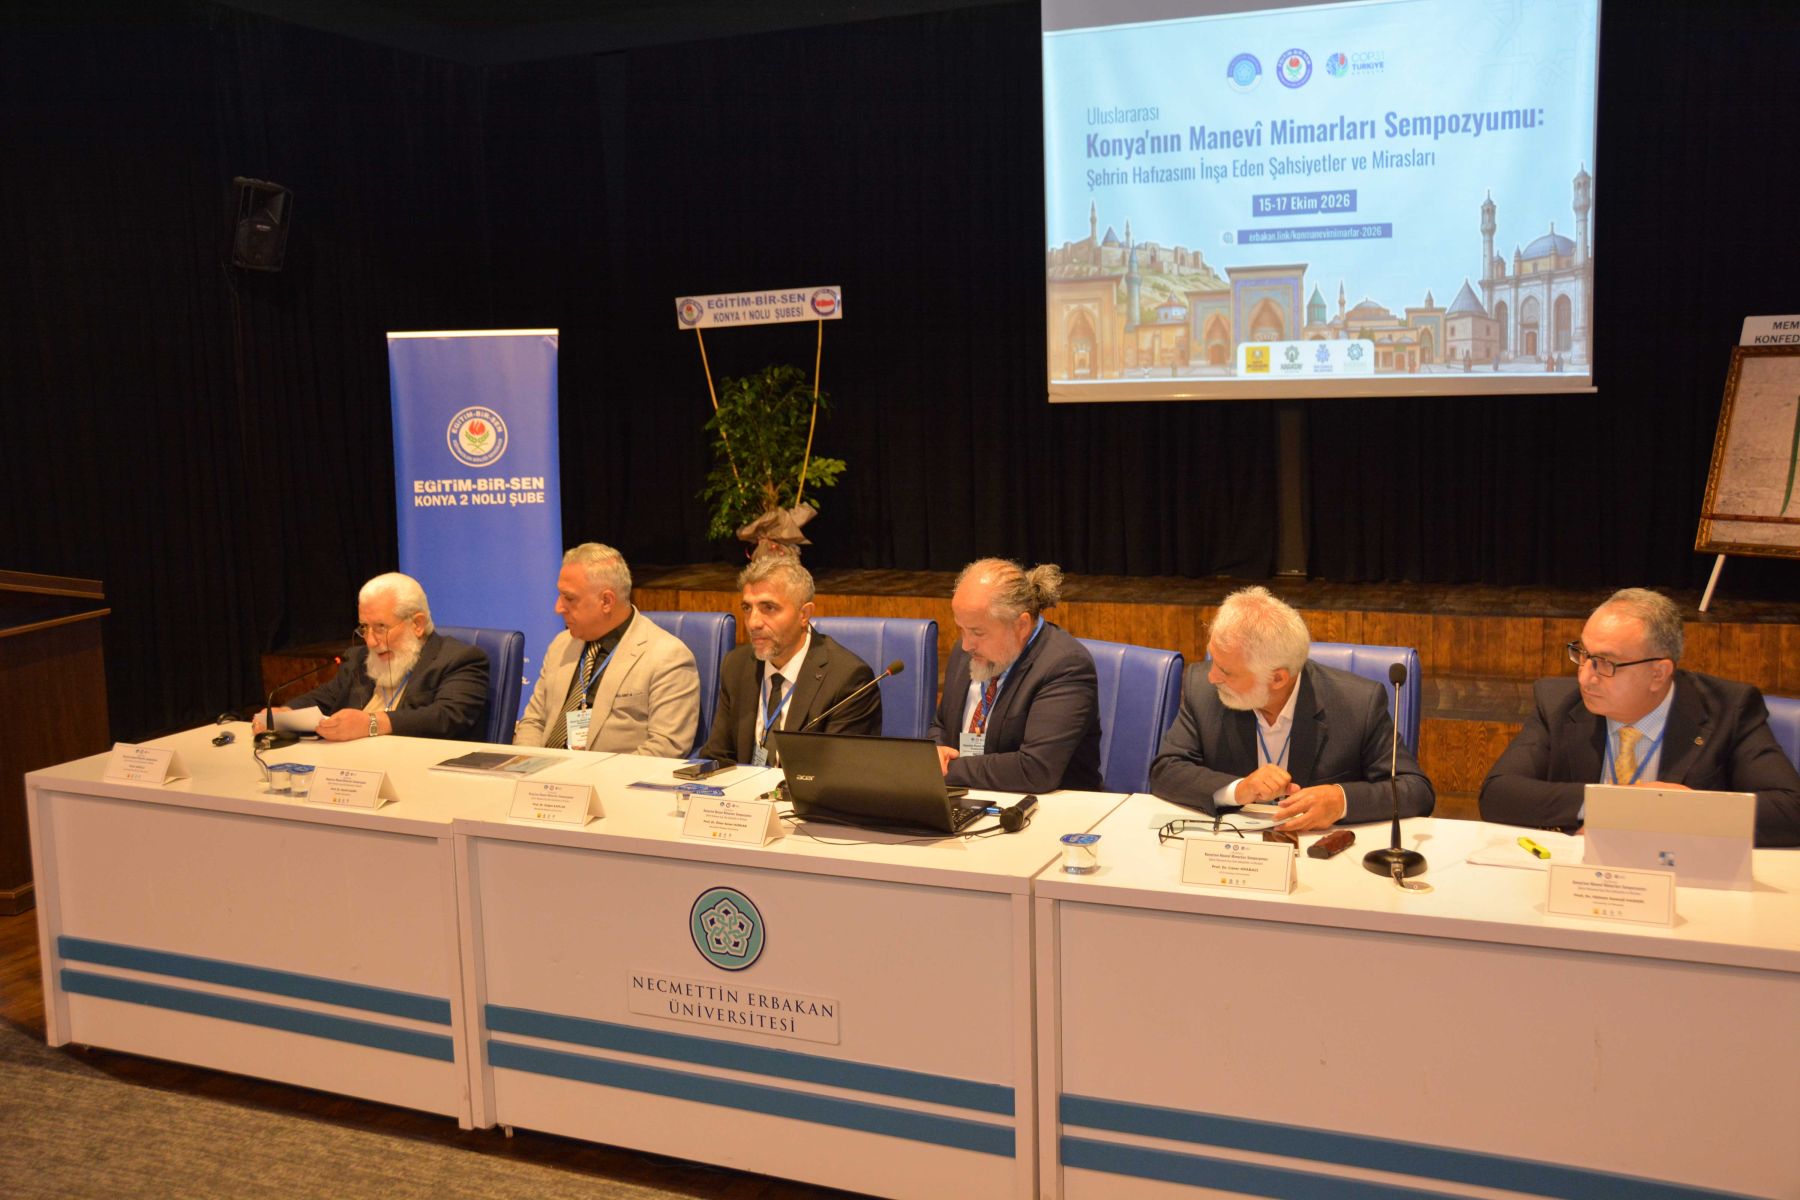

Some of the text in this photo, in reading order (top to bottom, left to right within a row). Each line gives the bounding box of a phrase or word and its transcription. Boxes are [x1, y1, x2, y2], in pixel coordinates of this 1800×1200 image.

[1087, 107, 1159, 126] Uluslararası
[1086, 108, 1544, 160] Konya'nın Manevî Mimarları Sempozyumu:
[1087, 148, 1435, 191] Şehrin Hafızasını İnşa Eden Şahsiyetler ve Mirasları
[1259, 193, 1350, 212] 15-17 Ekim 2026
[713, 311, 740, 322] KONYA
[749, 309, 770, 320] NOLU
[414, 492, 545, 507] KONYA 2 NOLU ŞUBE
[633, 976, 834, 1018] NECMETTİN ERBAKAN
[669, 999, 795, 1033] ÜNİVERSİTESİ
